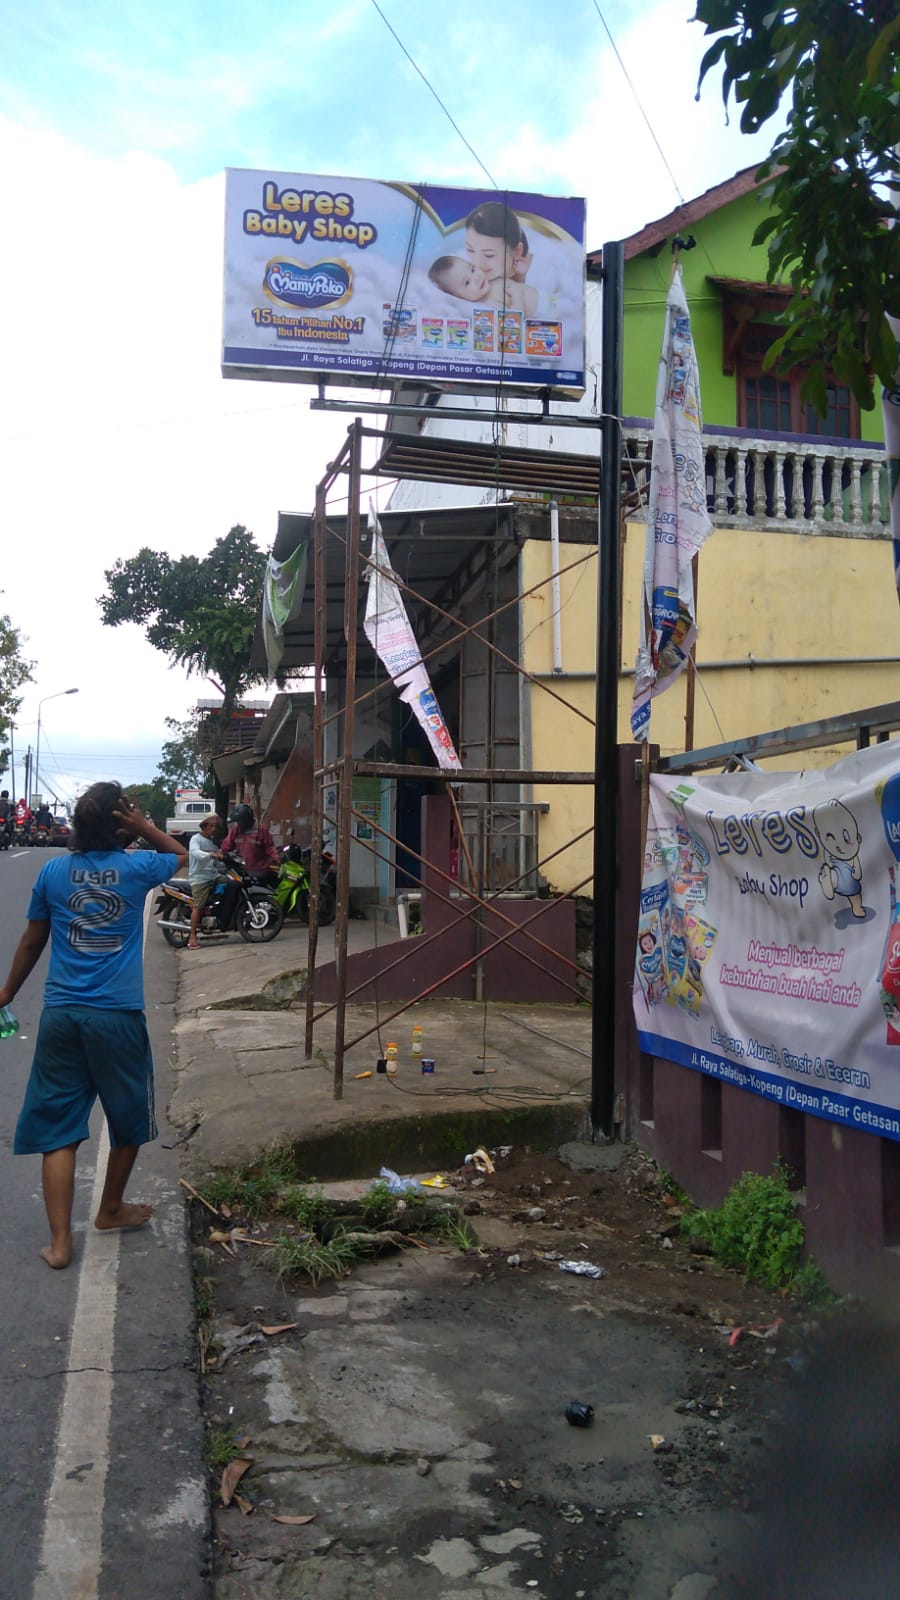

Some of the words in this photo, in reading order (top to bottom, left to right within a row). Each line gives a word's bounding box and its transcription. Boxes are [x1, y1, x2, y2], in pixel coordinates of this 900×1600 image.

[263, 182, 353, 217] Leres
[244, 211, 308, 242] Baby
[312, 217, 375, 247] Shop
[269, 271, 345, 296] MamyPoko
[252, 307, 272, 324] 15
[272, 315, 299, 326] tahun
[300, 317, 332, 329] Pilihan
[332, 315, 364, 331] No.1
[278, 326, 293, 338] Ibu
[301, 354, 311, 362] Jl.
[313, 355, 335, 365] Raya
[337, 356, 373, 367] Salatiga
[382, 360, 415, 371] Kopeng
[416, 362, 447, 373] (Depan
[449, 364, 473, 374] Pasar
[705, 806, 819, 859] Leres
[71, 868, 119, 887] USA
[769, 873, 809, 909] Shop
[67, 887, 124, 953] 2
[748, 941, 792, 968] Menjual
[792, 945, 844, 976] berbagai
[720, 963, 778, 993] kebutuhan
[777, 973, 808, 999] buah
[807, 977, 833, 1003] hati
[831, 981, 861, 1008] anda
[781, 1048, 813, 1076] Grosir
[815, 1057, 826, 1079] &
[825, 1060, 870, 1089] Eceran
[700, 1055, 718, 1074] Raya
[785, 1085, 819, 1108] (Depan
[821, 1096, 850, 1118] Pasar
